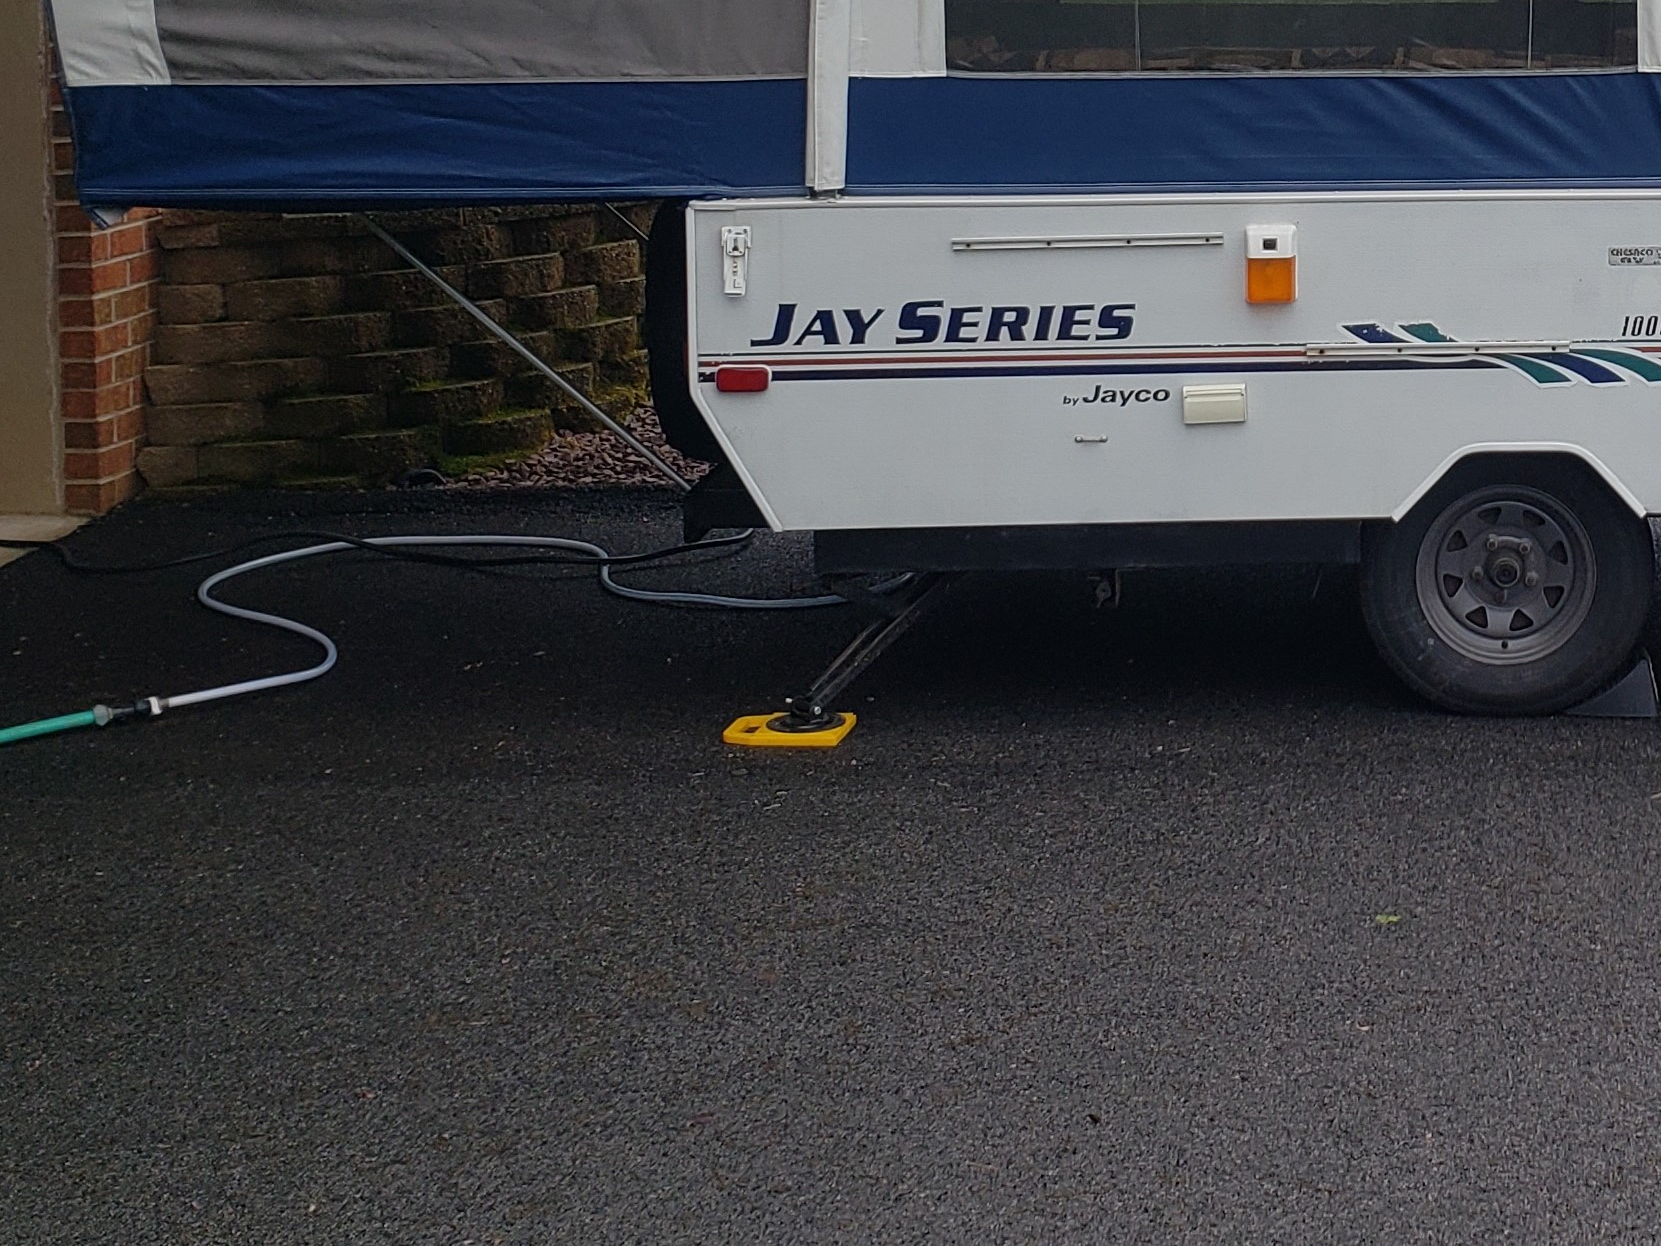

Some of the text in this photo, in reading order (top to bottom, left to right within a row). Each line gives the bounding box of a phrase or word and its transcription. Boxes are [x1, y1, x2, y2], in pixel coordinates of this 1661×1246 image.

[750, 300, 1136, 347] JAY SERIES
[1063, 384, 1171, 407] by Jayco
